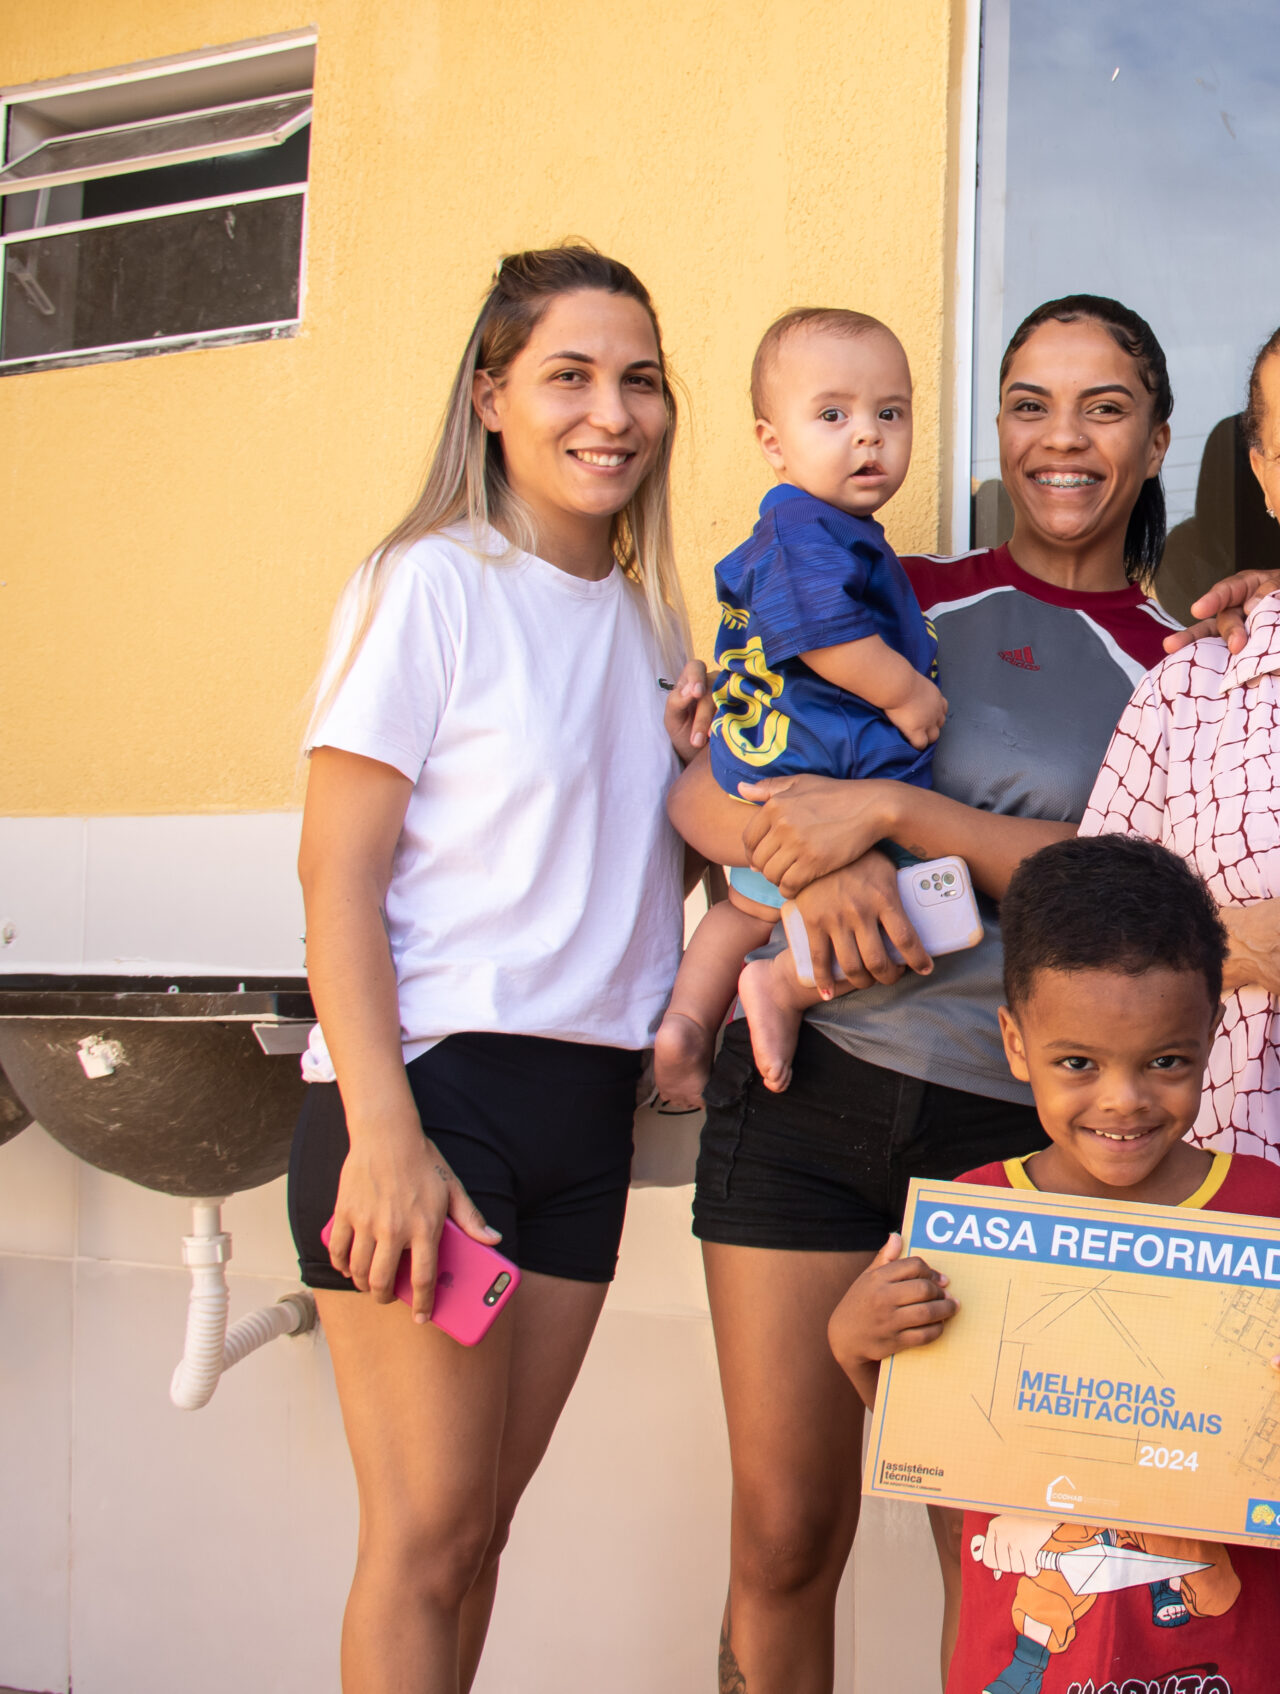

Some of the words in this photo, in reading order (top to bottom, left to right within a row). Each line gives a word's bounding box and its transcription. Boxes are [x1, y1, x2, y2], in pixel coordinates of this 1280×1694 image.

[925, 1210, 1037, 1254] CASA
[1020, 1370, 1176, 1408] MELHORIAS
[1017, 1391, 1223, 1435] HABITACIONAIS
[886, 1462, 944, 1476] assistência
[1138, 1446, 1199, 1472] 2024
[885, 1470, 922, 1483] técnica
